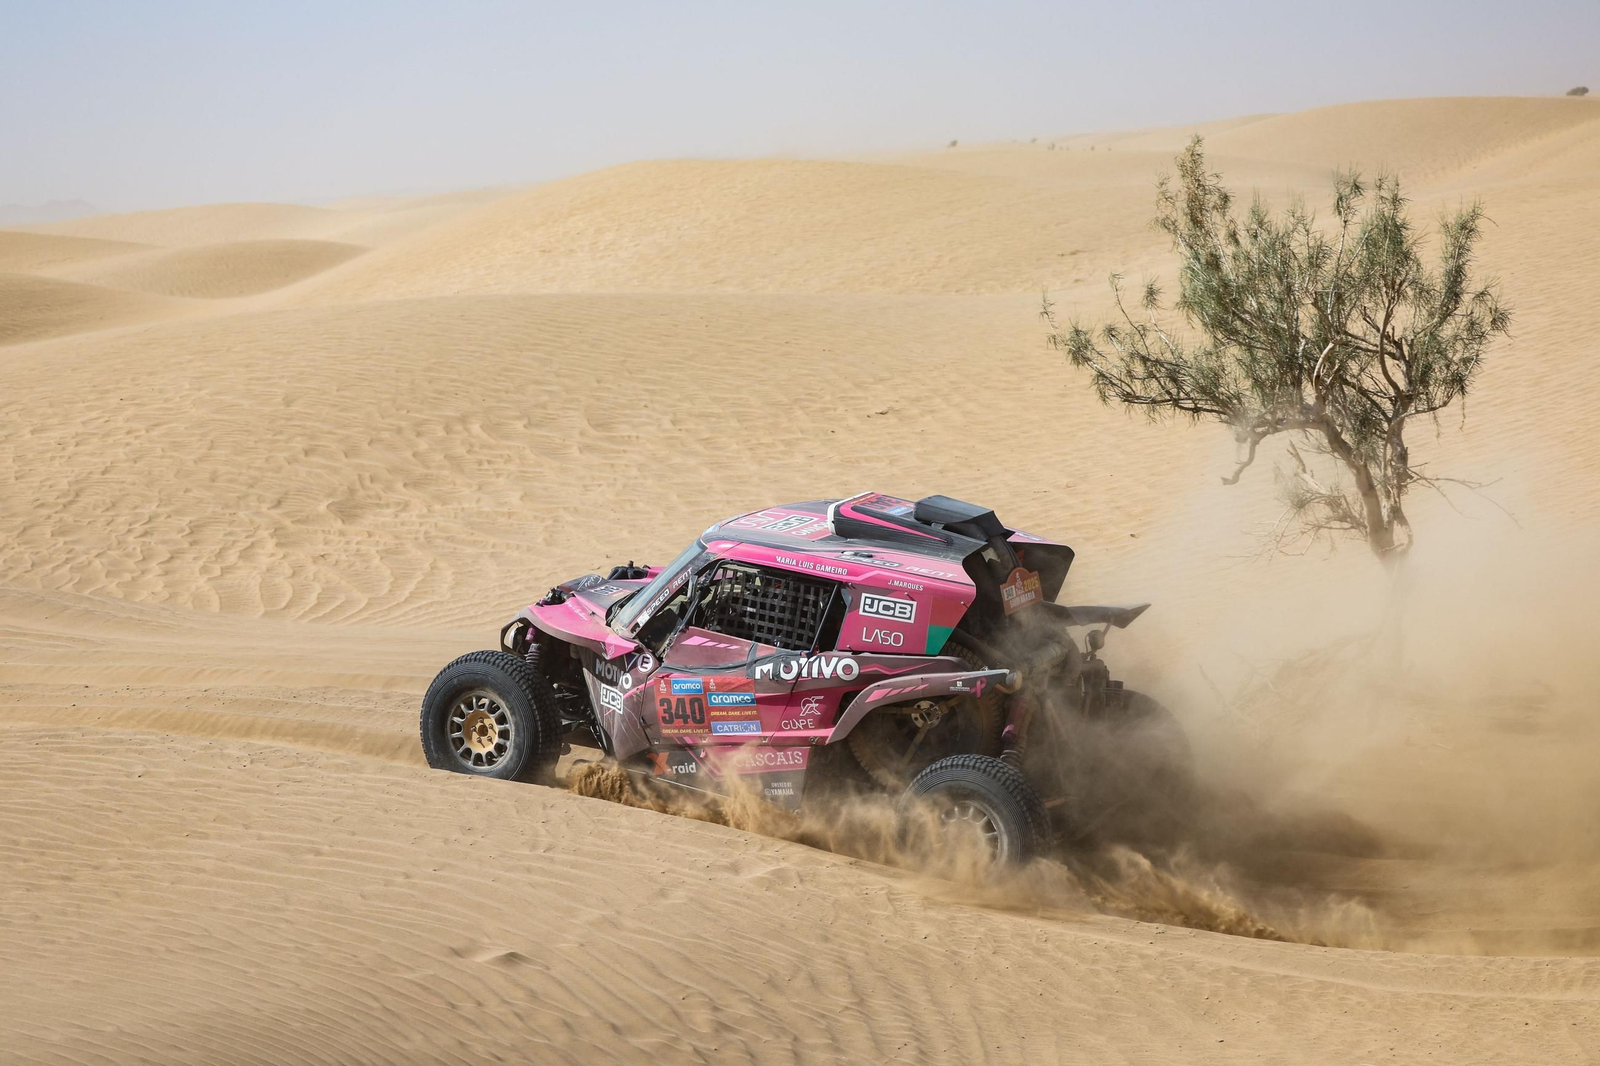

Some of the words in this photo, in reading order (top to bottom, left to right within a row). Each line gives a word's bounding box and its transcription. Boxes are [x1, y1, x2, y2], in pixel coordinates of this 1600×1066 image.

[775, 555, 797, 566] MARIA
[798, 560, 814, 569] LUIS
[815, 563, 848, 576] GAMEIRO
[887, 579, 924, 592] J.MARQUES
[646, 588, 670, 616] SPEED
[864, 598, 912, 620] JCB
[862, 627, 904, 647] LASO
[755, 656, 860, 681] MOTIVO
[711, 694, 752, 704] aramco
[659, 697, 706, 725] 340
[770, 788, 795, 796] YAMAHA
